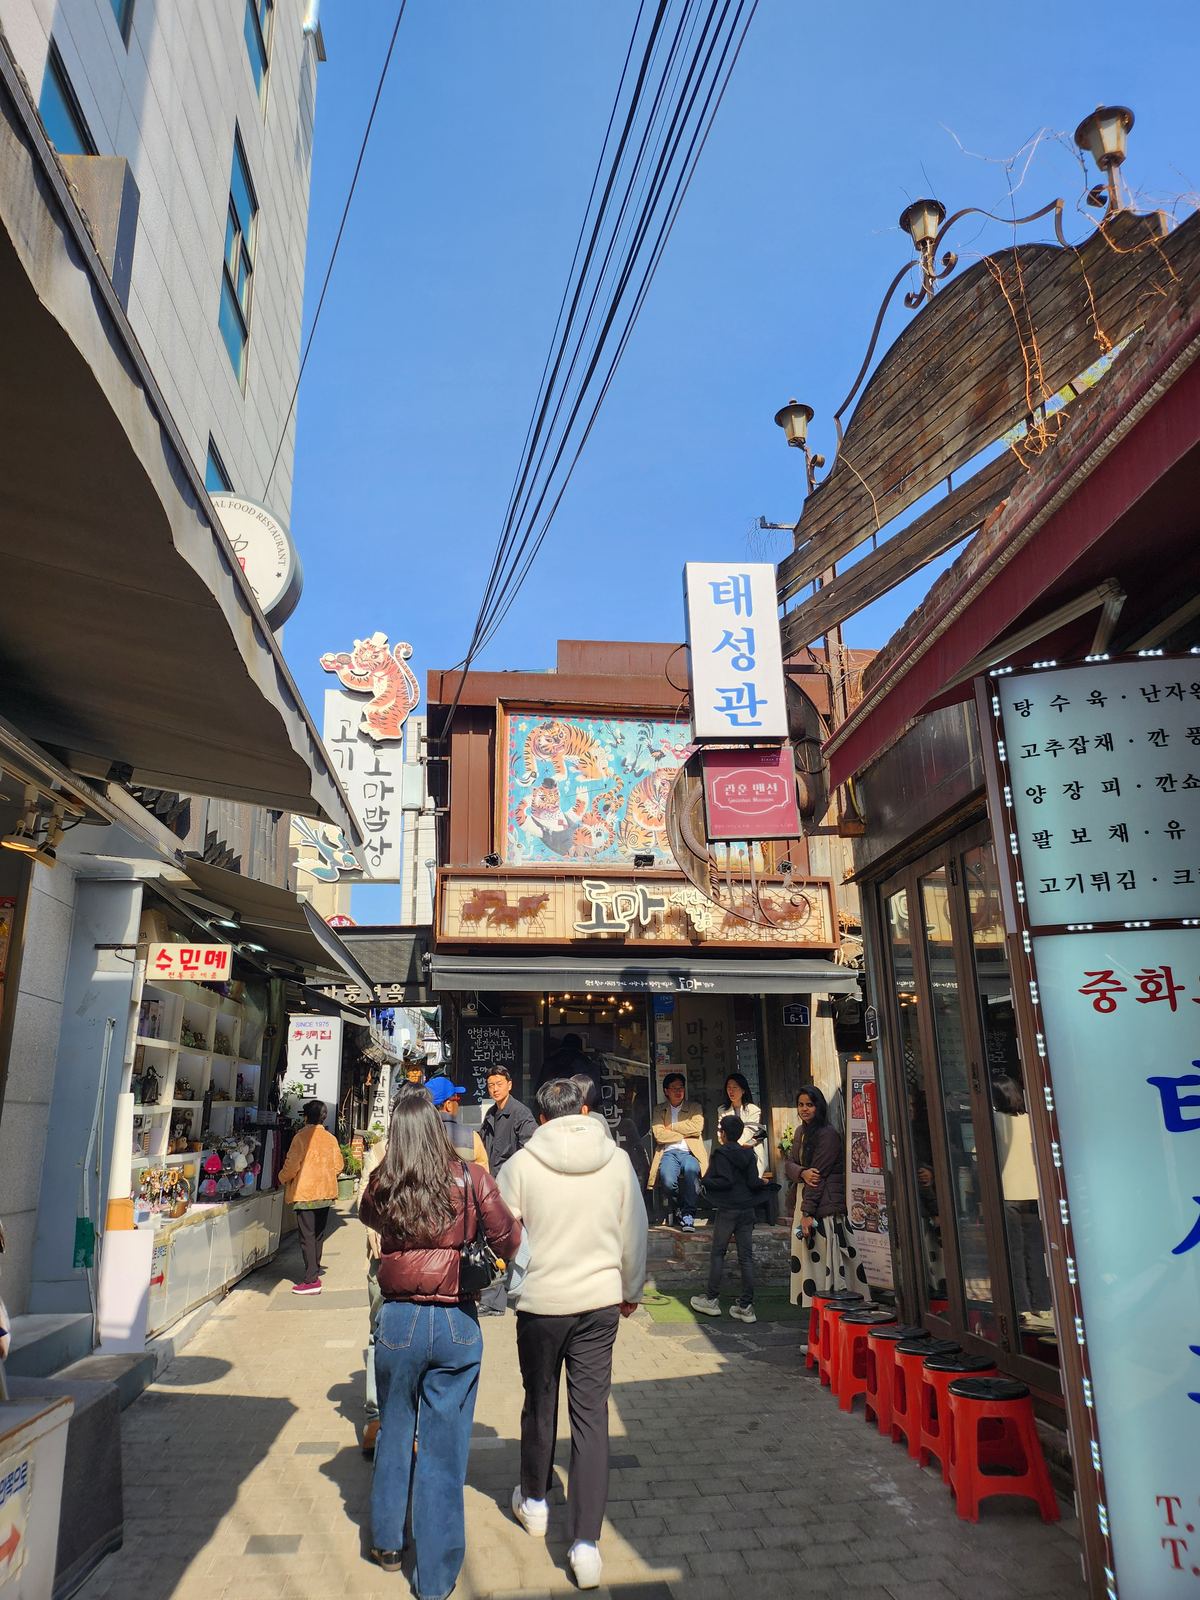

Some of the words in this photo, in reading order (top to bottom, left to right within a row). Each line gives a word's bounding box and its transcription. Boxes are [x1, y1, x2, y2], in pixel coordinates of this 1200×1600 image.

[228, 501, 257, 516] FOOD
[256, 512, 287, 567] RESTAURANT
[708, 573, 769, 728] 태성관
[1020, 732, 1114, 759] 고추잡채
[1164, 820, 1186, 840] 유
[1039, 869, 1137, 894] 고기튀김
[1173, 868, 1200, 885] 크
[573, 880, 669, 933] 도마
[1077, 965, 1200, 1013] 중화
[467, 1027, 509, 1040] 안녕하세요
[789, 1014, 804, 1023] 6-1
[299, 1043, 322, 1115] 사동면
